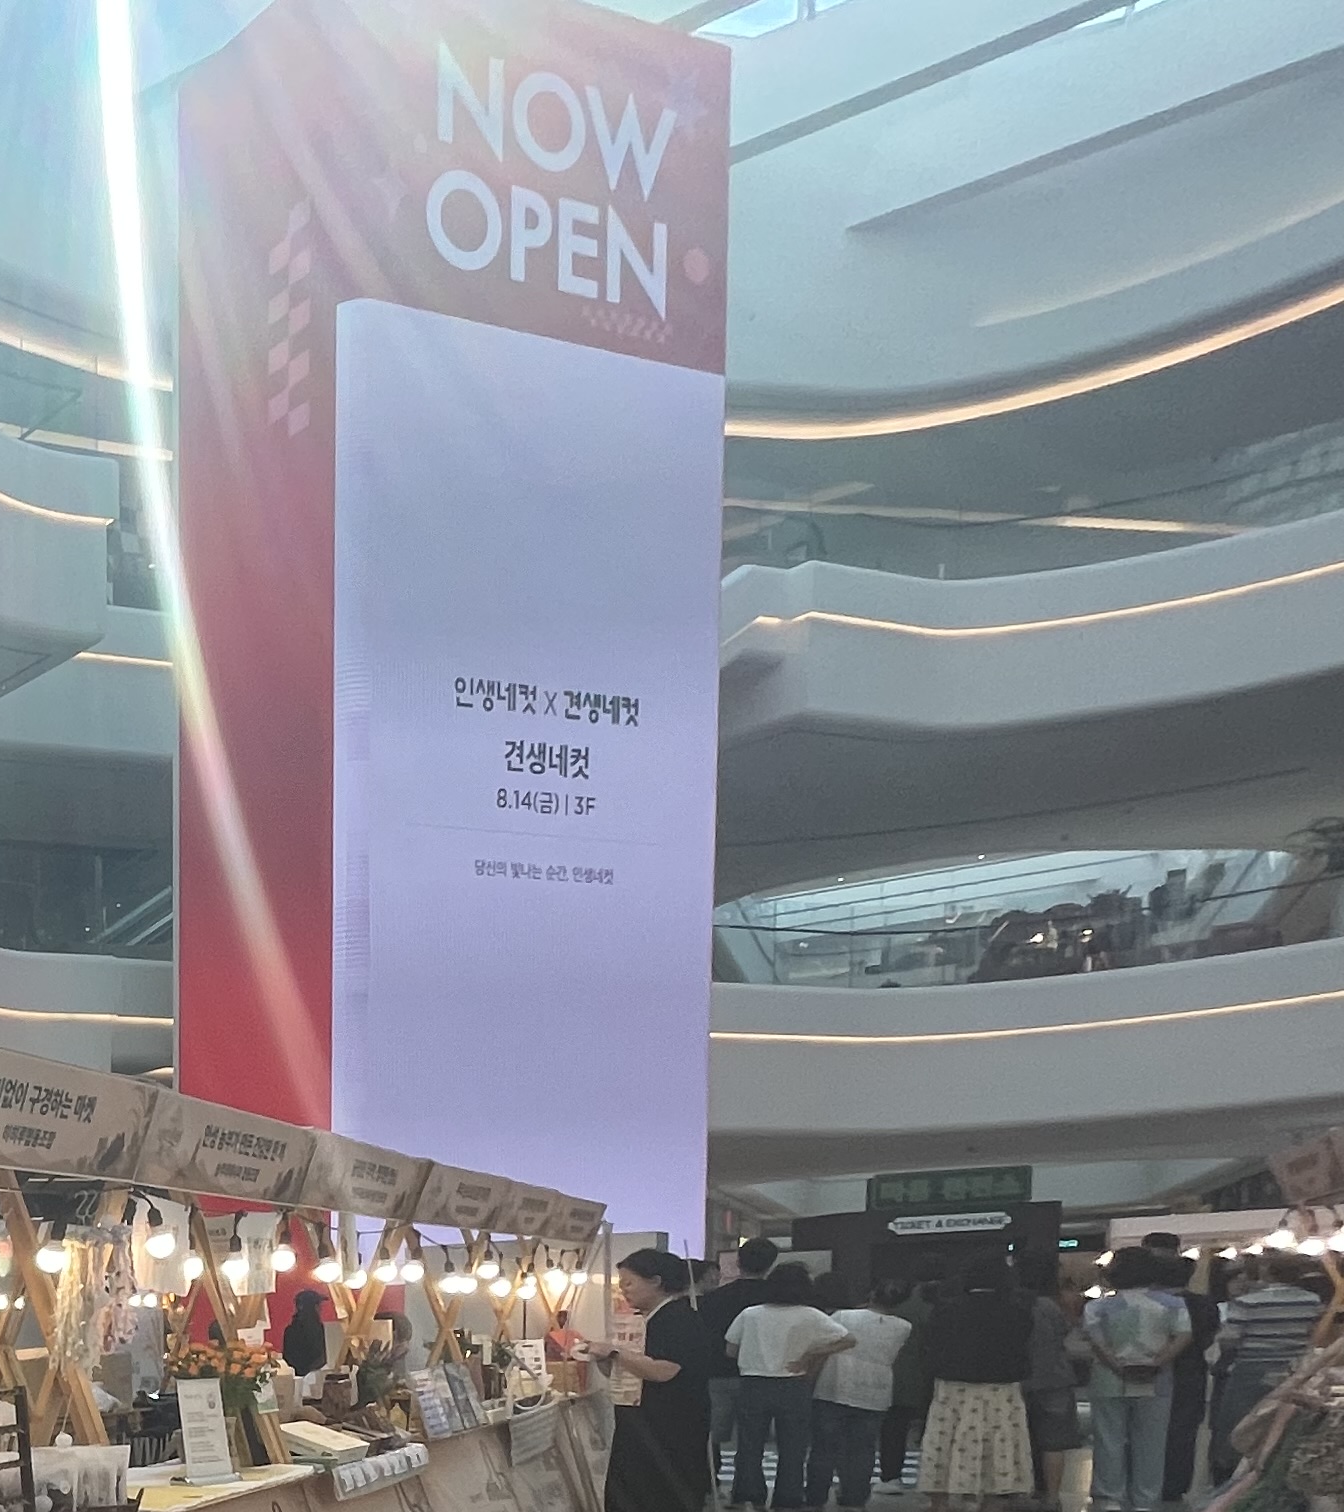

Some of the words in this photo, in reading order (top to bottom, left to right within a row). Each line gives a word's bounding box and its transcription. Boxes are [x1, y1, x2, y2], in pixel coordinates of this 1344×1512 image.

[437, 41, 677, 203] NOW
[425, 169, 669, 320] OPEN
[454, 676, 537, 715] 인생네컷
[563, 690, 640, 727] 견생네컷
[504, 740, 590, 780] 견생네컷
[496, 788, 560, 815] 8.14(금)
[573, 796, 597, 816] 3F
[474, 859, 507, 878] 당신의
[29, 1085, 74, 1120] 구경하는
